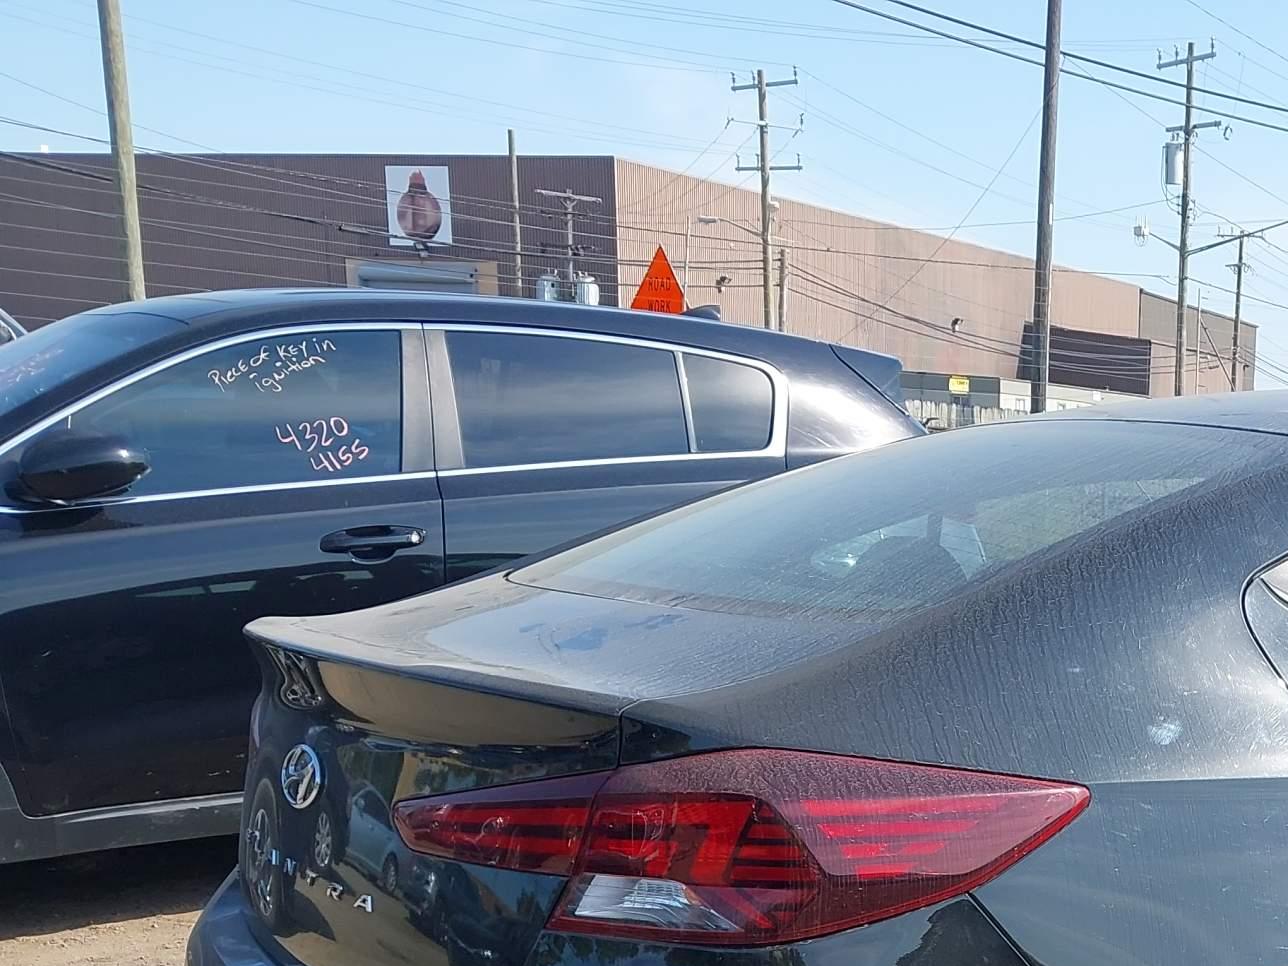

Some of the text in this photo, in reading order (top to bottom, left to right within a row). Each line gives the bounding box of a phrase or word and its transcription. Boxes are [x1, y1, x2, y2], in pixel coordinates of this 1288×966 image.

[647, 277, 671, 291] ROAD
[647, 300, 671, 313] WORK
[312, 337, 337, 354] in
[249, 355, 326, 393] ignition
[275, 416, 349, 452] 4320
[310, 438, 369, 472] 4155
